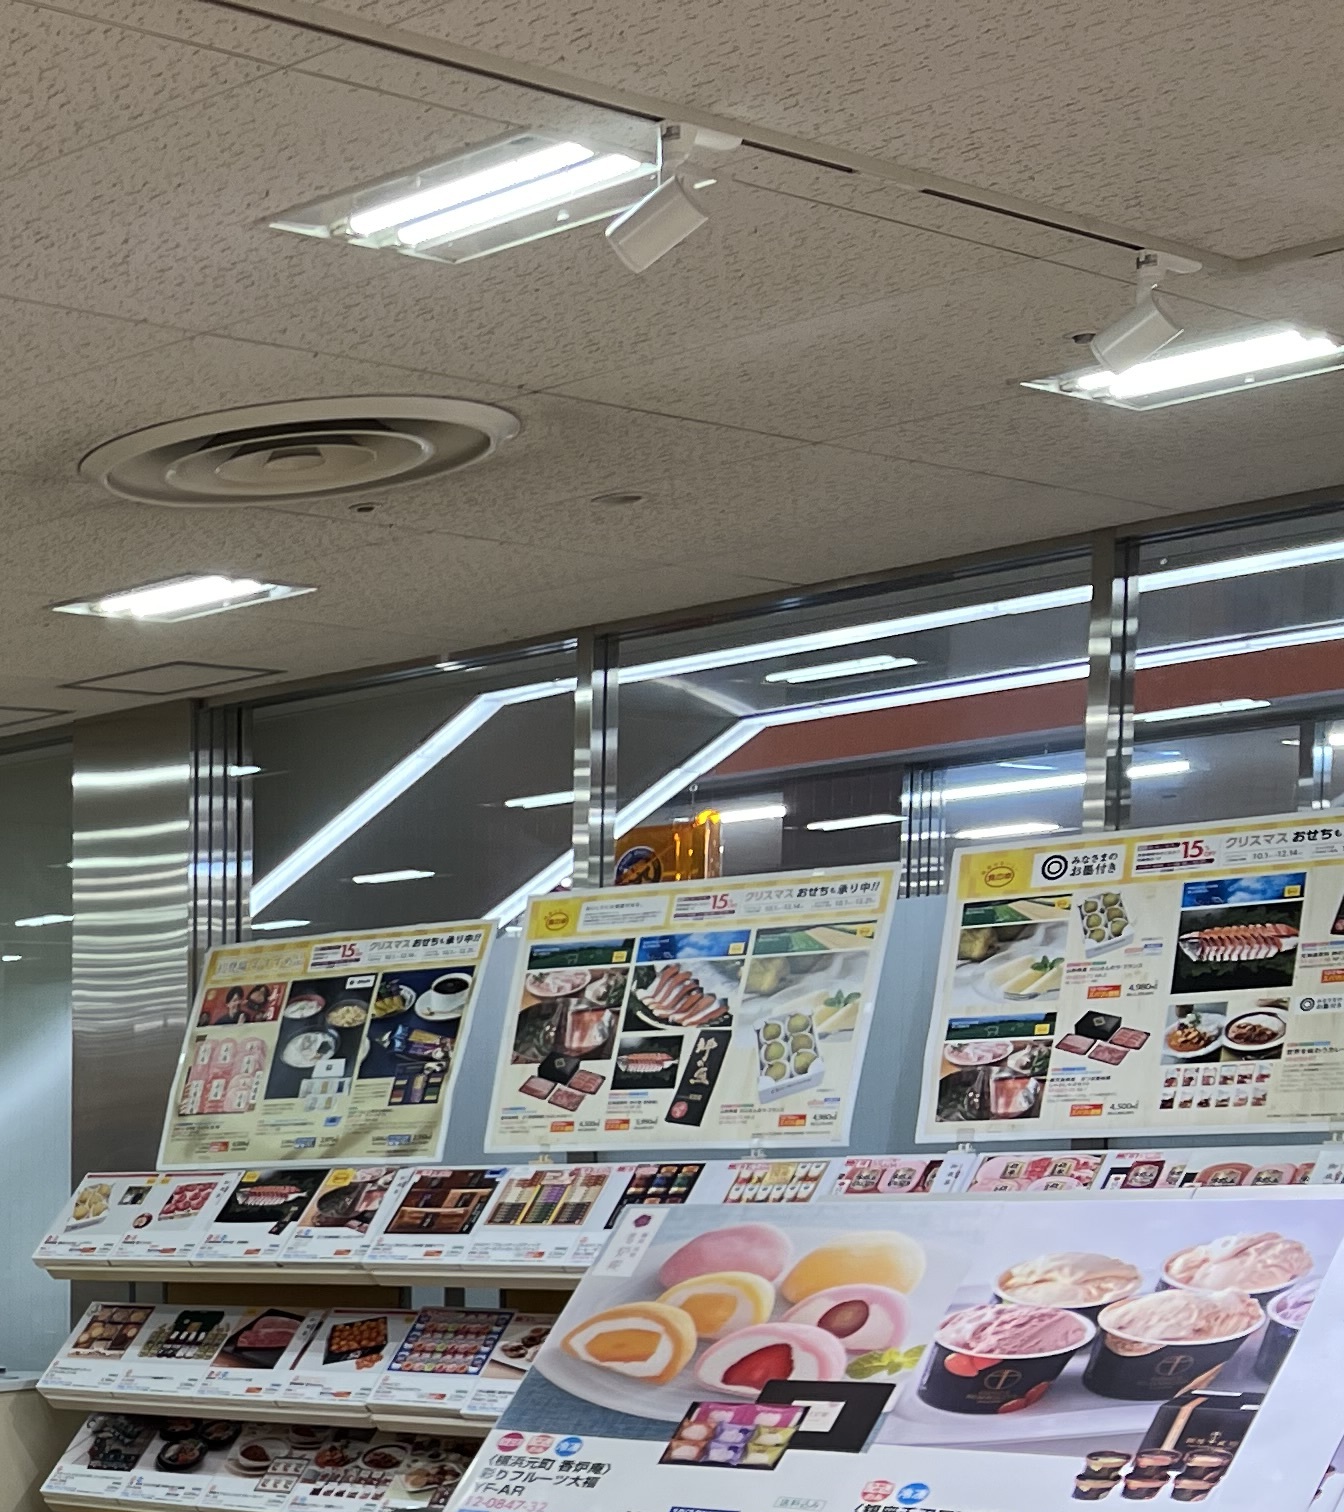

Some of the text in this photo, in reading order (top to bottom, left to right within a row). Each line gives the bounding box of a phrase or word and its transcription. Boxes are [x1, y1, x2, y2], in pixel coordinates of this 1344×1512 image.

[1225, 833, 1289, 848] クリスマス
